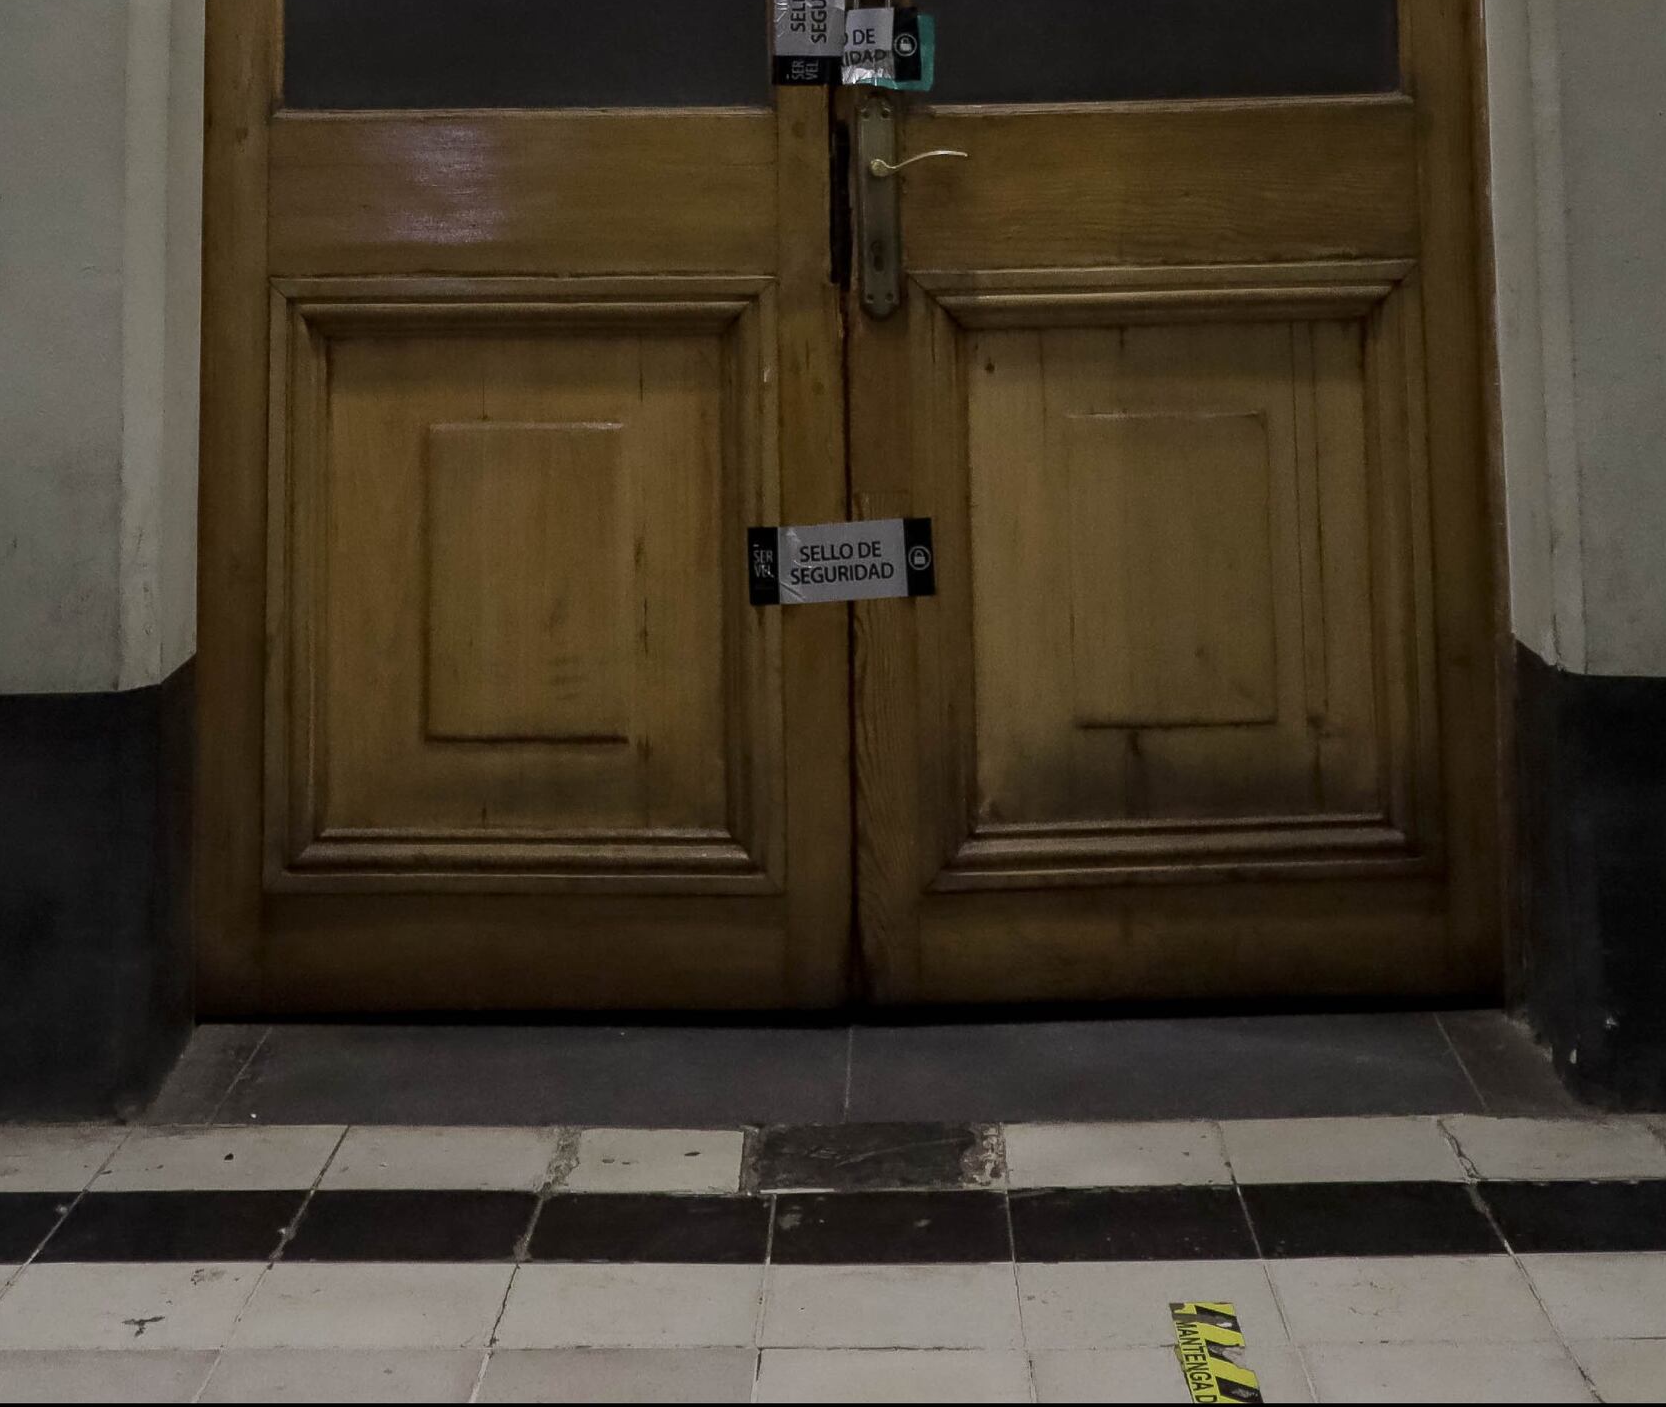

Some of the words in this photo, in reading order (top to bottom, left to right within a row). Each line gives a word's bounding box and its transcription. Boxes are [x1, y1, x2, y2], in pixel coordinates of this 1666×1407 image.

[852, 28, 876, 45] DE
[791, 59, 805, 81] SER
[805, 58, 820, 81] VEL
[753, 549, 774, 563] SER
[799, 543, 854, 563] SELLO
[857, 541, 882, 558] DE
[790, 561, 895, 585] SEGURIDAD
[1175, 1321, 1215, 1392] MANTENGA
